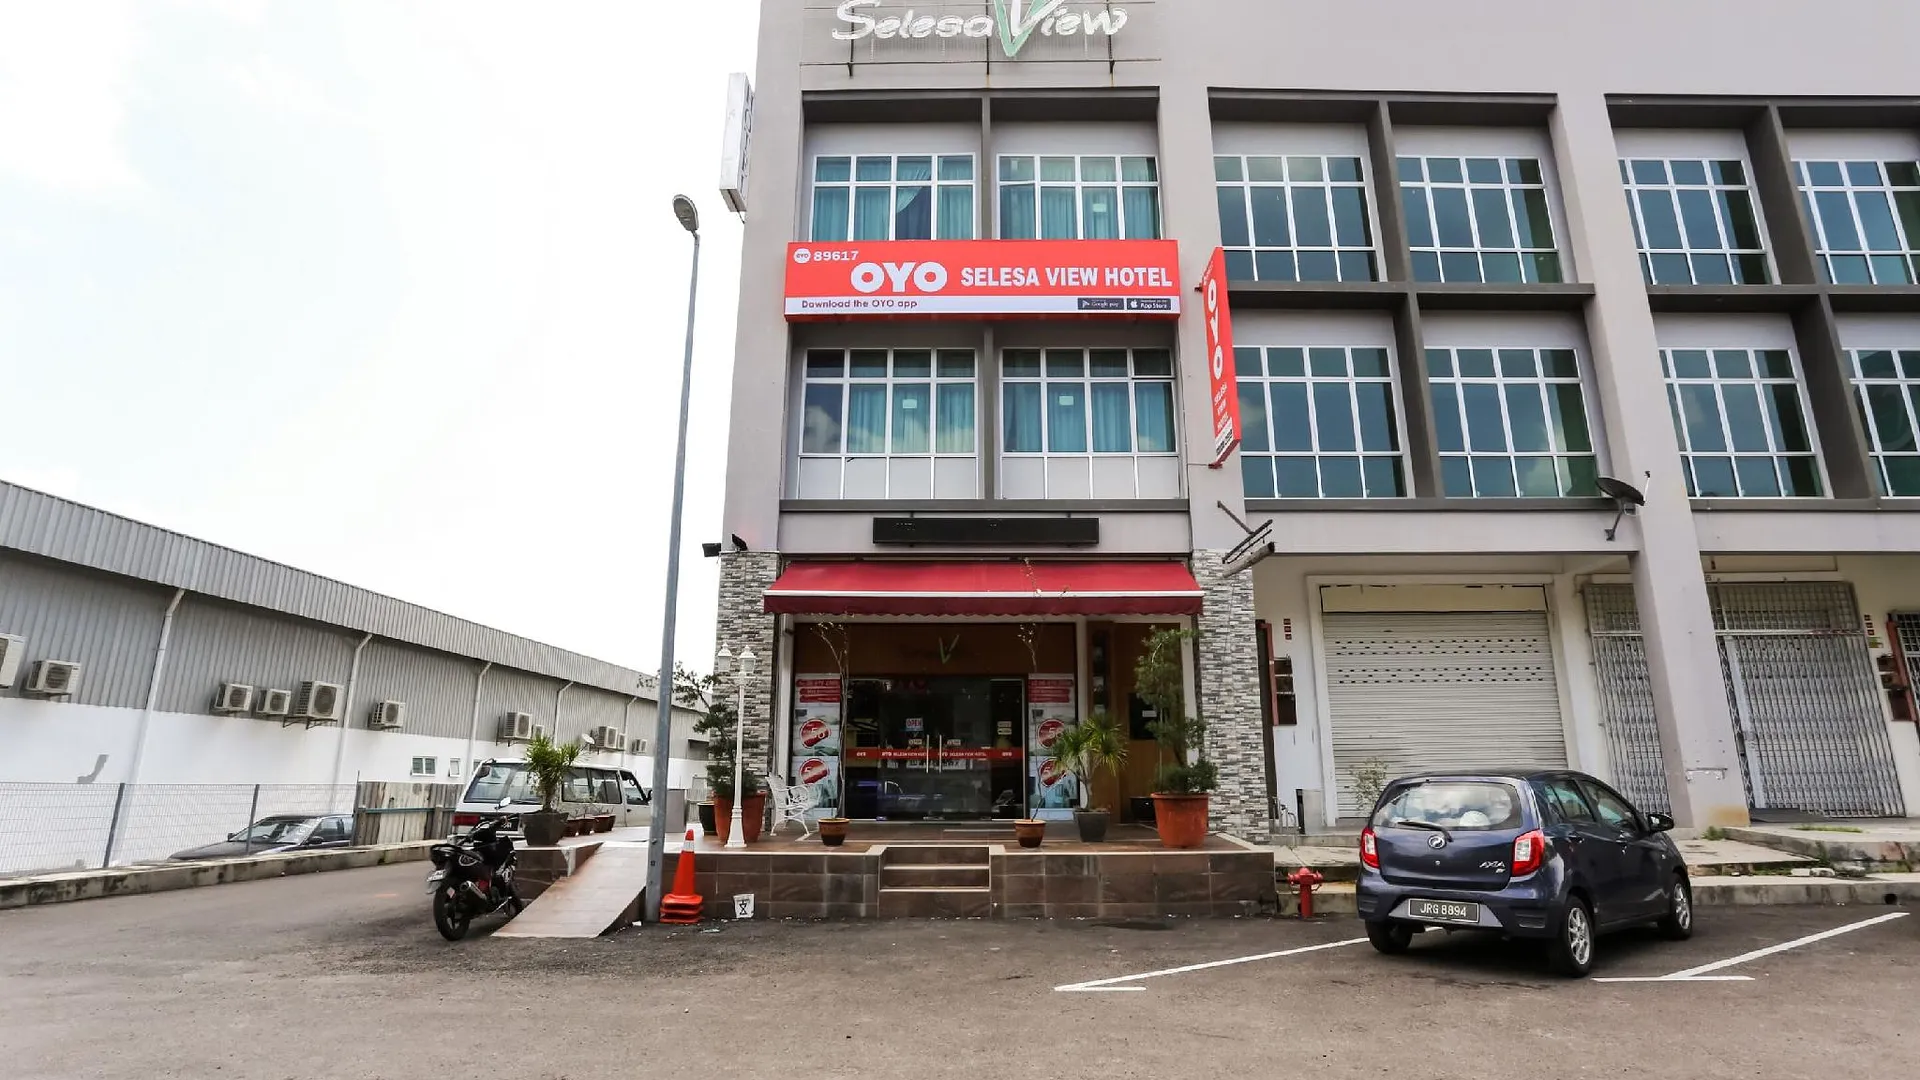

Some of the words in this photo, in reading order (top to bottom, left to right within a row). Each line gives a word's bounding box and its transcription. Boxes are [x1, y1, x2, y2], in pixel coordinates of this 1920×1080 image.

[832, 0, 993, 40] Selesa
[994, 0, 1128, 57] View
[813, 250, 859, 262] 89617
[850, 261, 948, 294] OYO
[960, 267, 1040, 287] SELESA
[1045, 267, 1098, 287] VIEW
[1105, 267, 1173, 287] HOTEL
[801, 299, 850, 309] Download
[853, 299, 868, 308] the
[872, 299, 894, 308] OYO
[897, 300, 918, 310] app
[1207, 278, 1223, 380] OYO
[1479, 860, 1505, 868] AXIA
[1420, 903, 1439, 914] JRG
[1441, 904, 1467, 917] 8894
